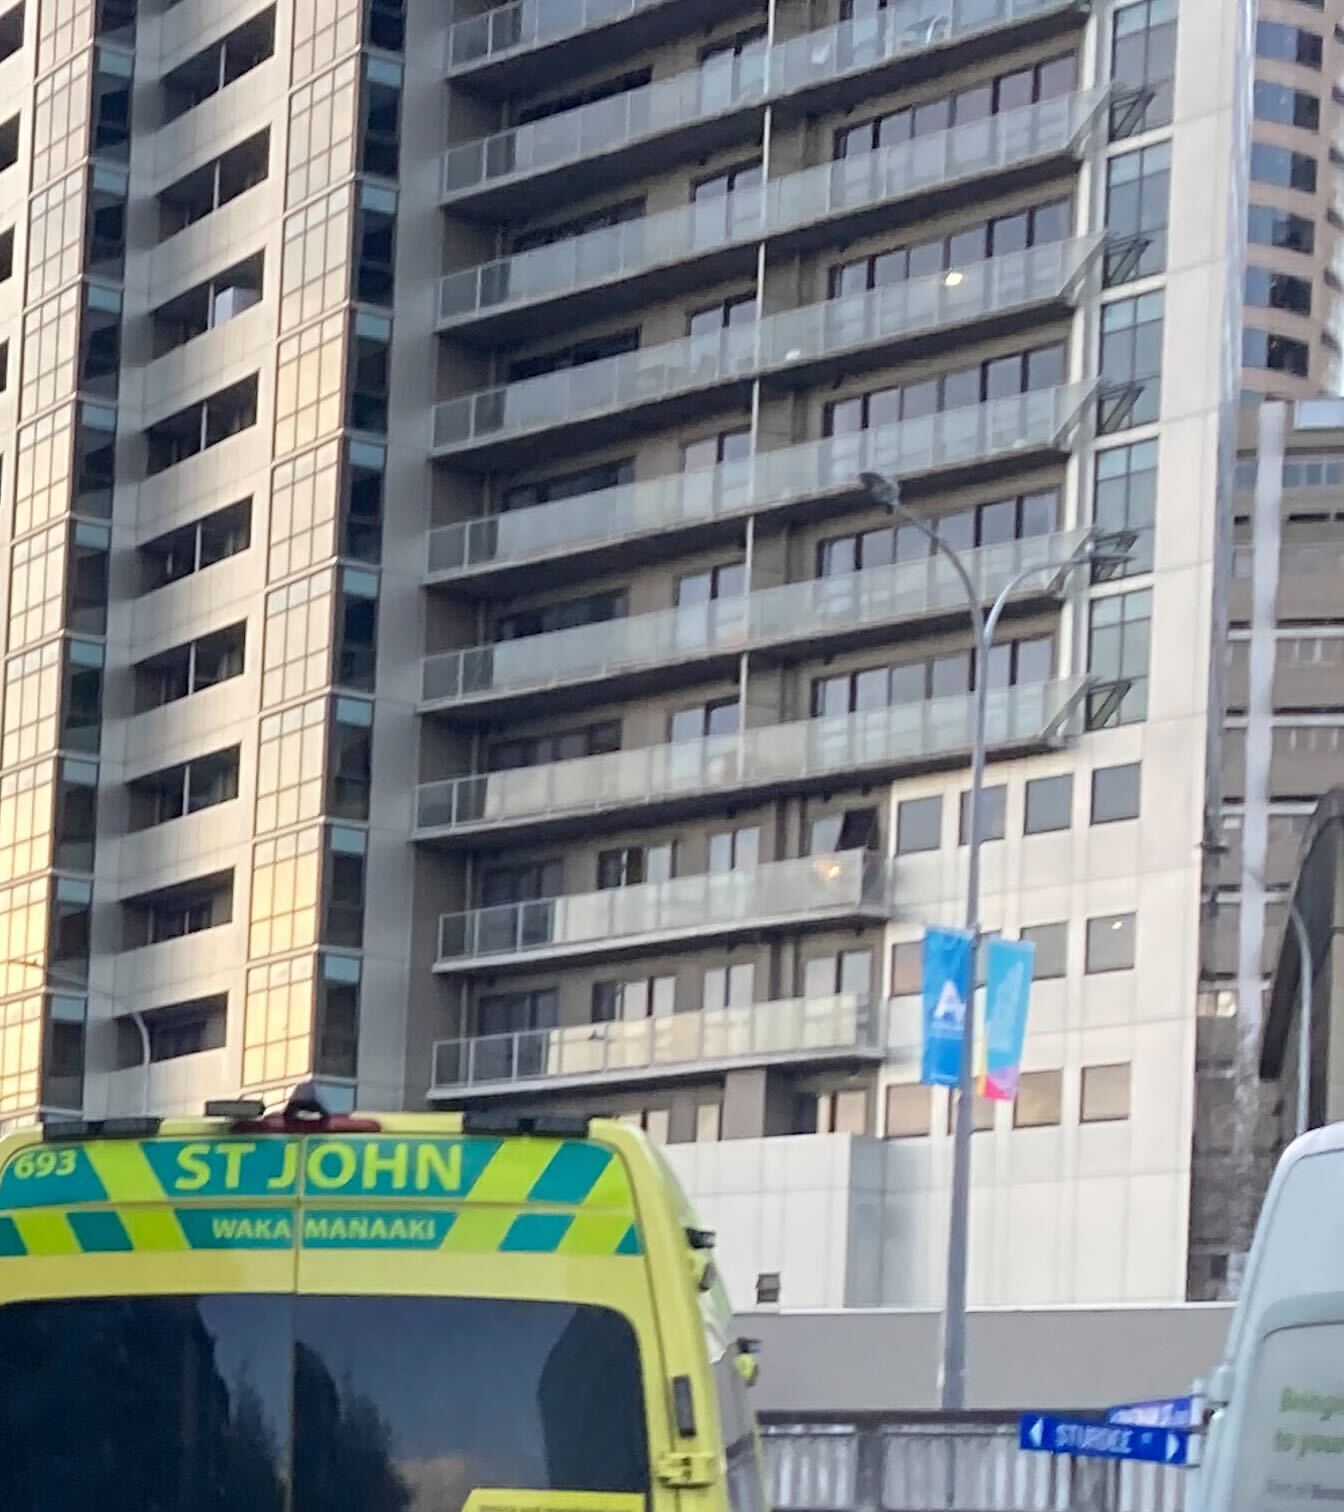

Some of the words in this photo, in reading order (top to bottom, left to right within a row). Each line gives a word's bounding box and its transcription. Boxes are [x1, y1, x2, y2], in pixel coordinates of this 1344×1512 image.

[14, 1148, 77, 1179] 693
[174, 1141, 256, 1191] ST
[270, 1141, 463, 1190] JOHN
[212, 1215, 291, 1241] WAKA
[305, 1214, 436, 1241] MANAAKI
